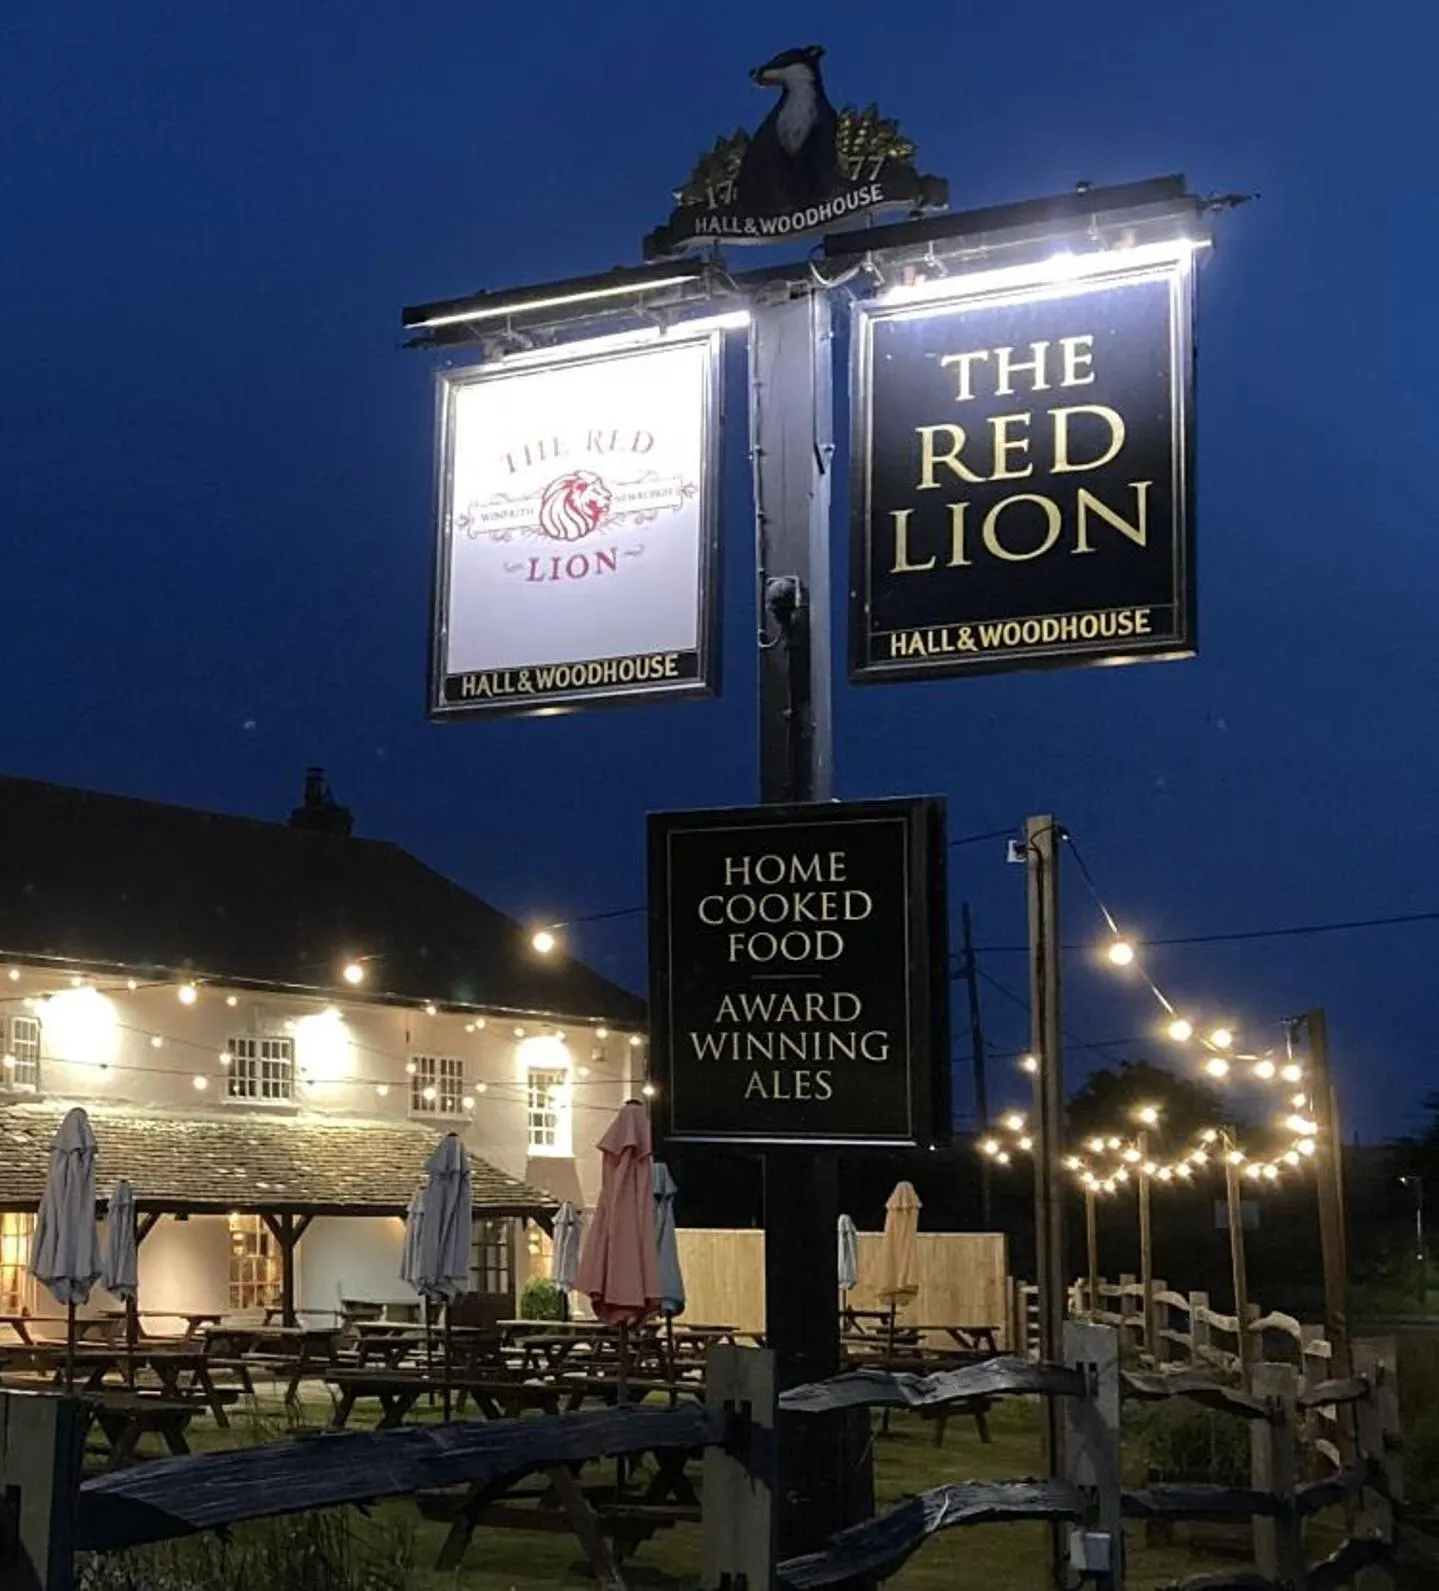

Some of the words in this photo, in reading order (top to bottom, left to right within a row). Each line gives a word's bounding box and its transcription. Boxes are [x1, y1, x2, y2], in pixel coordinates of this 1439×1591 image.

[849, 156, 885, 181] 77
[939, 334, 1095, 402] THE
[915, 404, 1126, 490] RED
[888, 481, 1153, 574] LION
[525, 547, 618, 583] LION
[724, 852, 847, 886] HOME
[698, 890, 873, 926] COOKED
[728, 930, 844, 962] FOOD
[715, 992, 862, 1023] AWARD
[689, 1030, 891, 1061] WINNING
[745, 1070, 833, 1101] ALES
